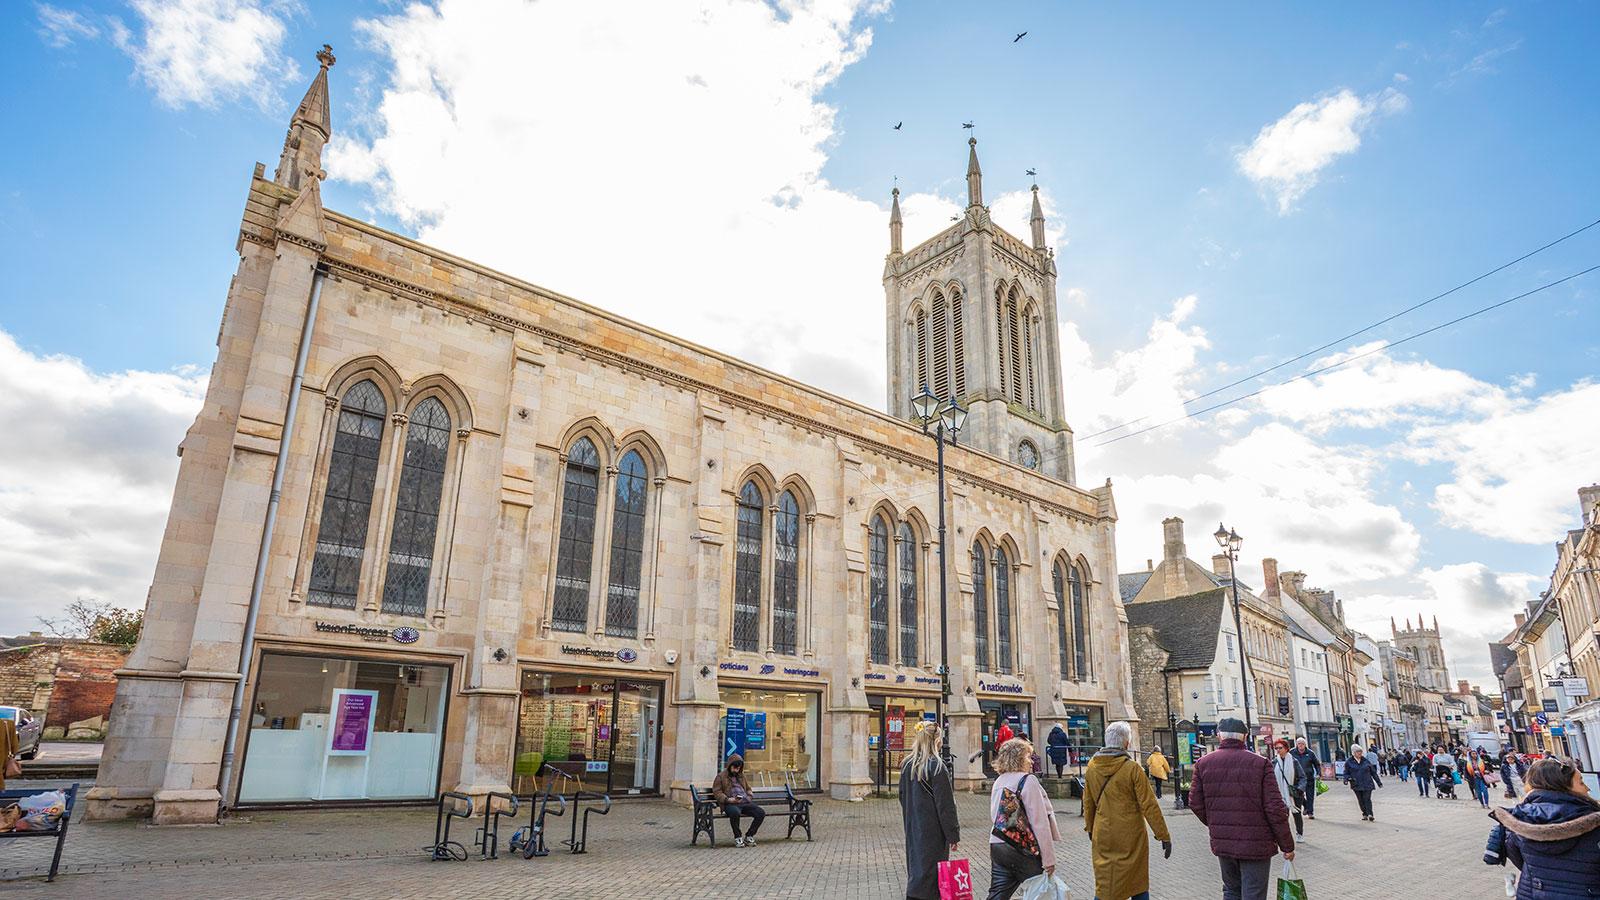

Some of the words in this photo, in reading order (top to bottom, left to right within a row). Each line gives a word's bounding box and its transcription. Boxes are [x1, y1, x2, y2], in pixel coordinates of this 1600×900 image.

[720, 662, 749, 671] opticians
[784, 667, 819, 677] hearingcare
[987, 683, 1023, 693] nationwide
